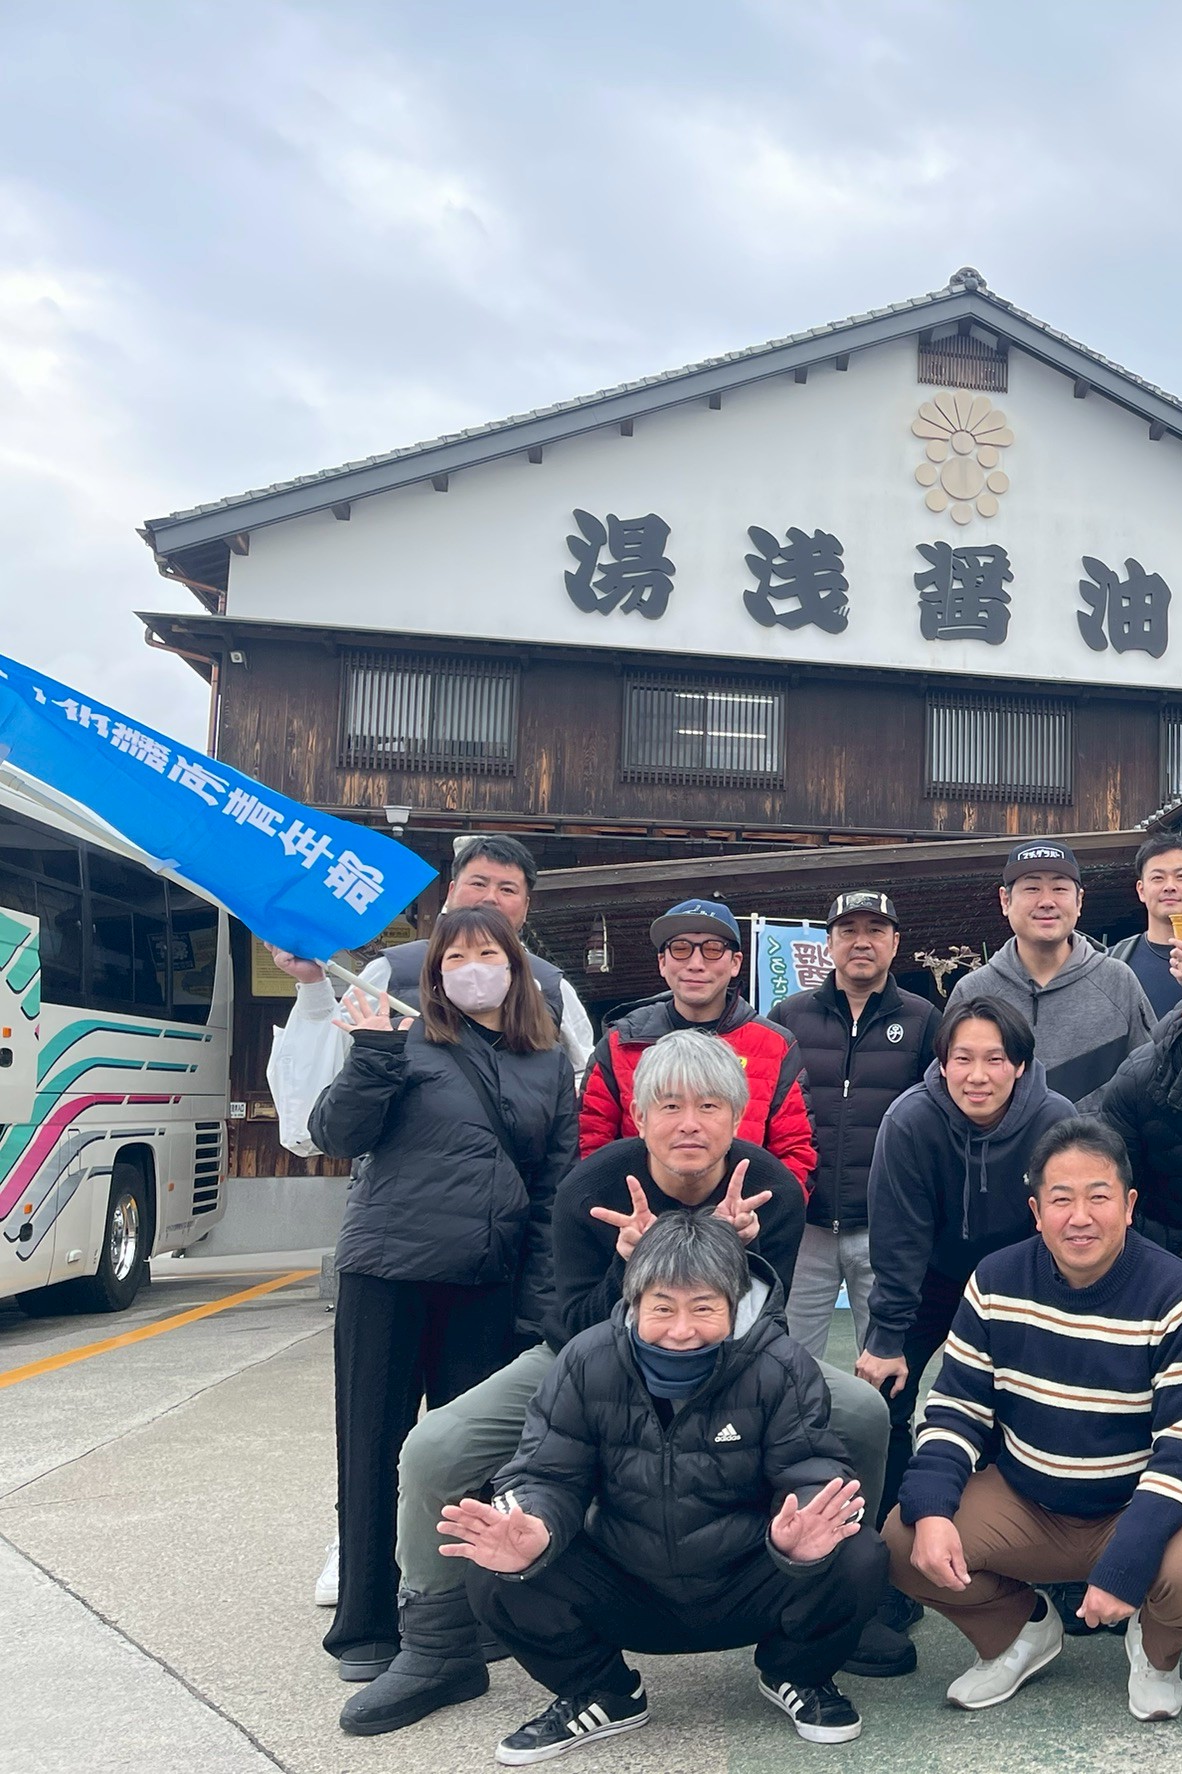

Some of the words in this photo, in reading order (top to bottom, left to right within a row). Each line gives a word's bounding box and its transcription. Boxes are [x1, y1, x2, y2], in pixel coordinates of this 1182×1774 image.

[0, 669, 386, 916] 会議所青年部
[714, 1434, 741, 1442] adidas
